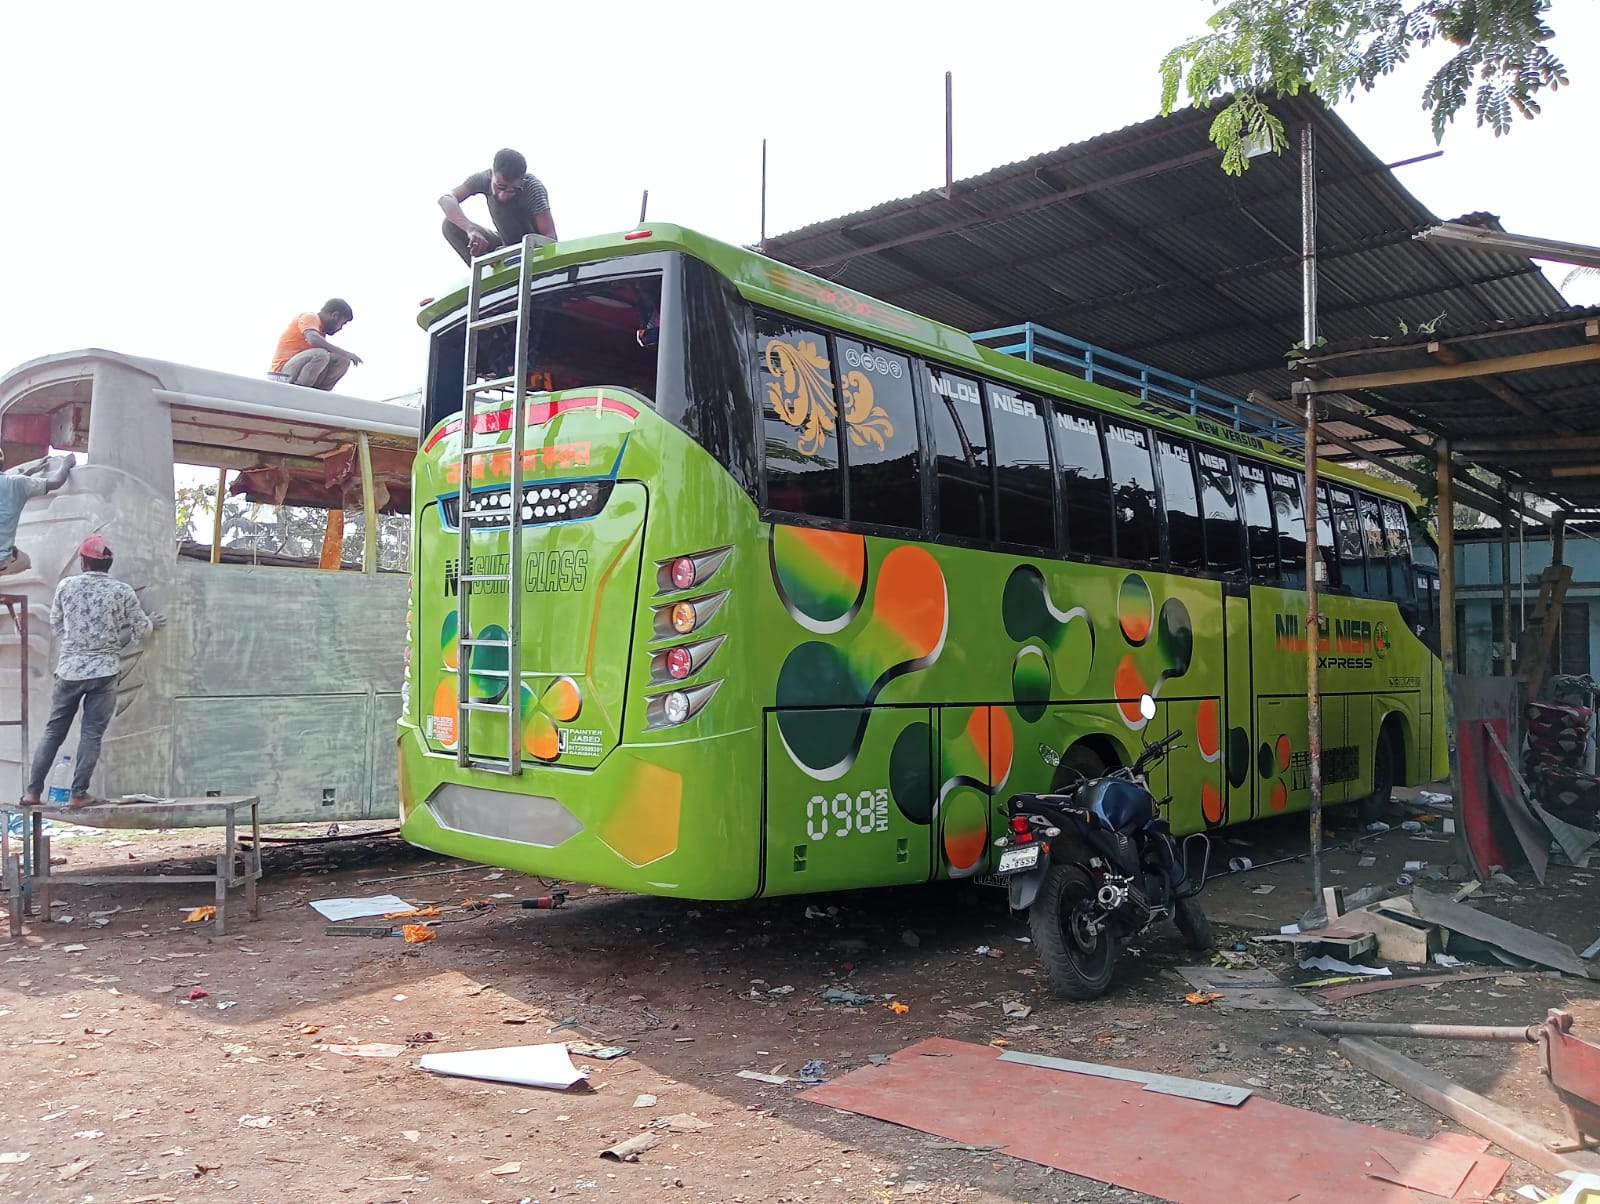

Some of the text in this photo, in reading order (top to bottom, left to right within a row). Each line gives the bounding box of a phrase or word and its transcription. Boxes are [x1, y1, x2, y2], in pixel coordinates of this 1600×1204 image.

[931, 377, 1037, 419] NILOY NISA
[1056, 412, 1146, 448] NILOY NISA
[1195, 419, 1264, 450] NEW VERSION
[1157, 440, 1228, 471] NILOY NISA
[1239, 464, 1297, 489] NILOY NISA
[474, 554, 511, 595] SUIT
[525, 550, 588, 593] CLASS
[1275, 613, 1372, 654] NILY NISA
[1318, 657, 1373, 669] XPRESS
[806, 788, 888, 841] 098 KM/H
